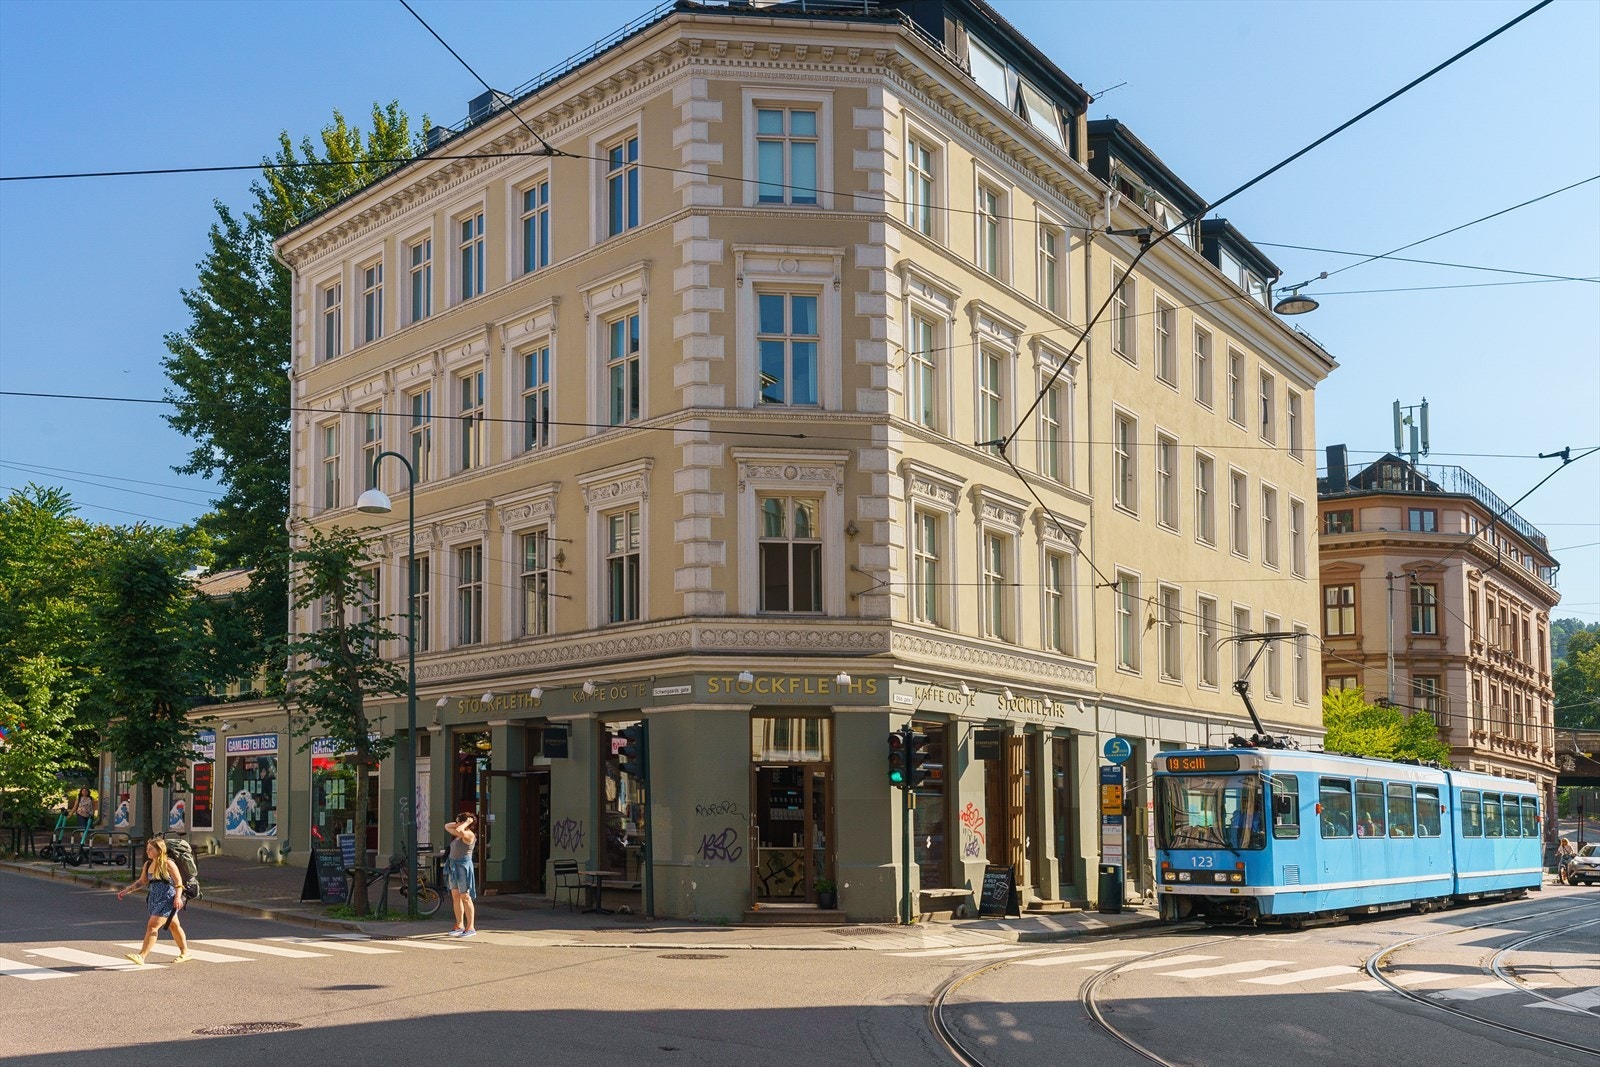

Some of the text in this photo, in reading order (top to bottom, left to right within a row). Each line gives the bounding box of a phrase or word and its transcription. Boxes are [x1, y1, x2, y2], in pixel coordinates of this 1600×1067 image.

[610, 685, 628, 699] OG
[632, 684, 646, 697] TE
[707, 677, 878, 694] STOCKFLETHS
[914, 687, 944, 702] KAFFE
[948, 691, 962, 705] OG
[458, 694, 542, 714] STOCKFLETHS
[228, 739, 260, 752] GAMLEBYEN
[261, 737, 276, 749] RENS
[1111, 741, 1121, 754] 5
[1169, 758, 1179, 770] 19
[1191, 856, 1213, 868] 123
